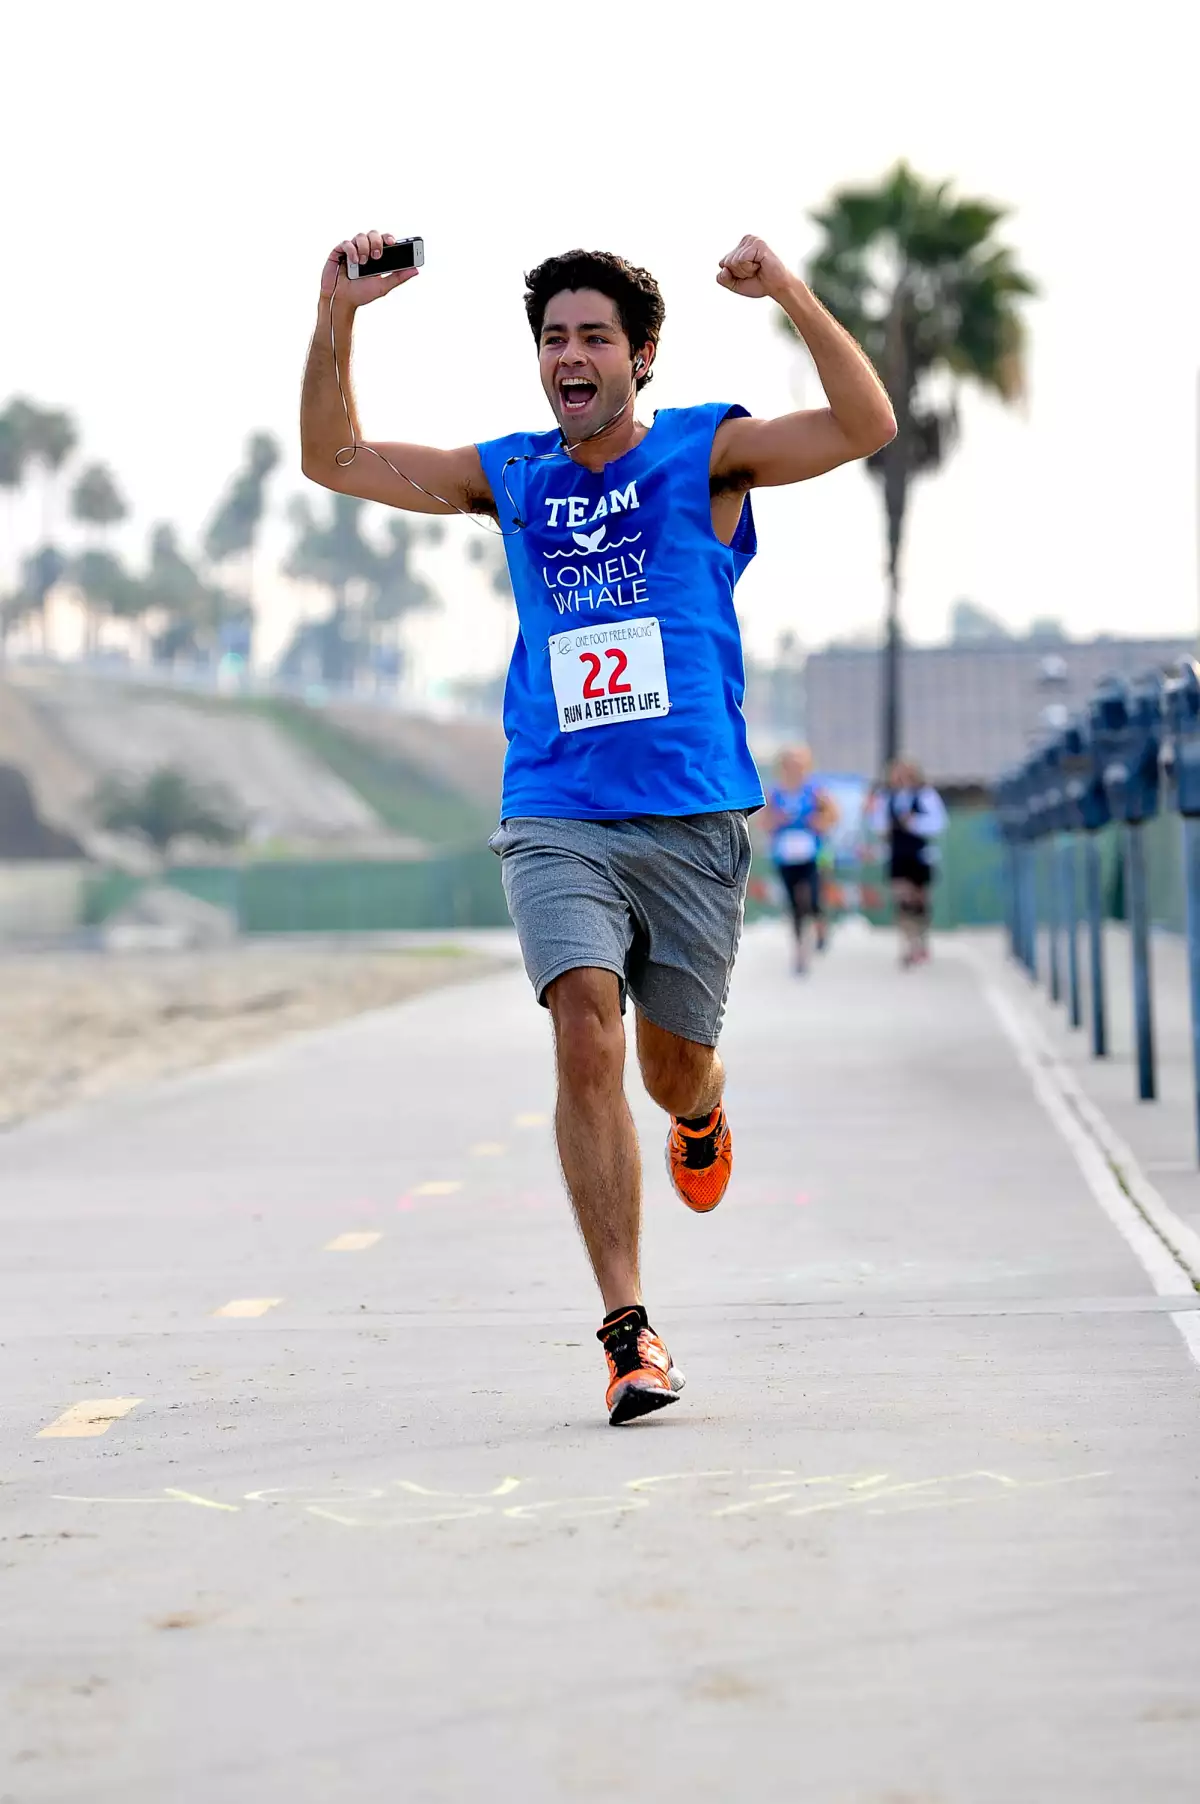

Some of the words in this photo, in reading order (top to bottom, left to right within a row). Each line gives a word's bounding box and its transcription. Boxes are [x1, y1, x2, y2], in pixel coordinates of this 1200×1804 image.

[544, 480, 640, 528] TEAM
[543, 549, 646, 588] LONELY
[552, 579, 649, 615] WHALE
[575, 635, 589, 648] ONE
[589, 631, 608, 645] FOOT
[609, 628, 627, 641] FREE
[627, 625, 652, 639] RACING
[579, 648, 631, 699] 22
[563, 703, 583, 724] RUN
[585, 702, 593, 720] A
[594, 695, 636, 718] BETTER
[638, 692, 661, 711] LIFE
